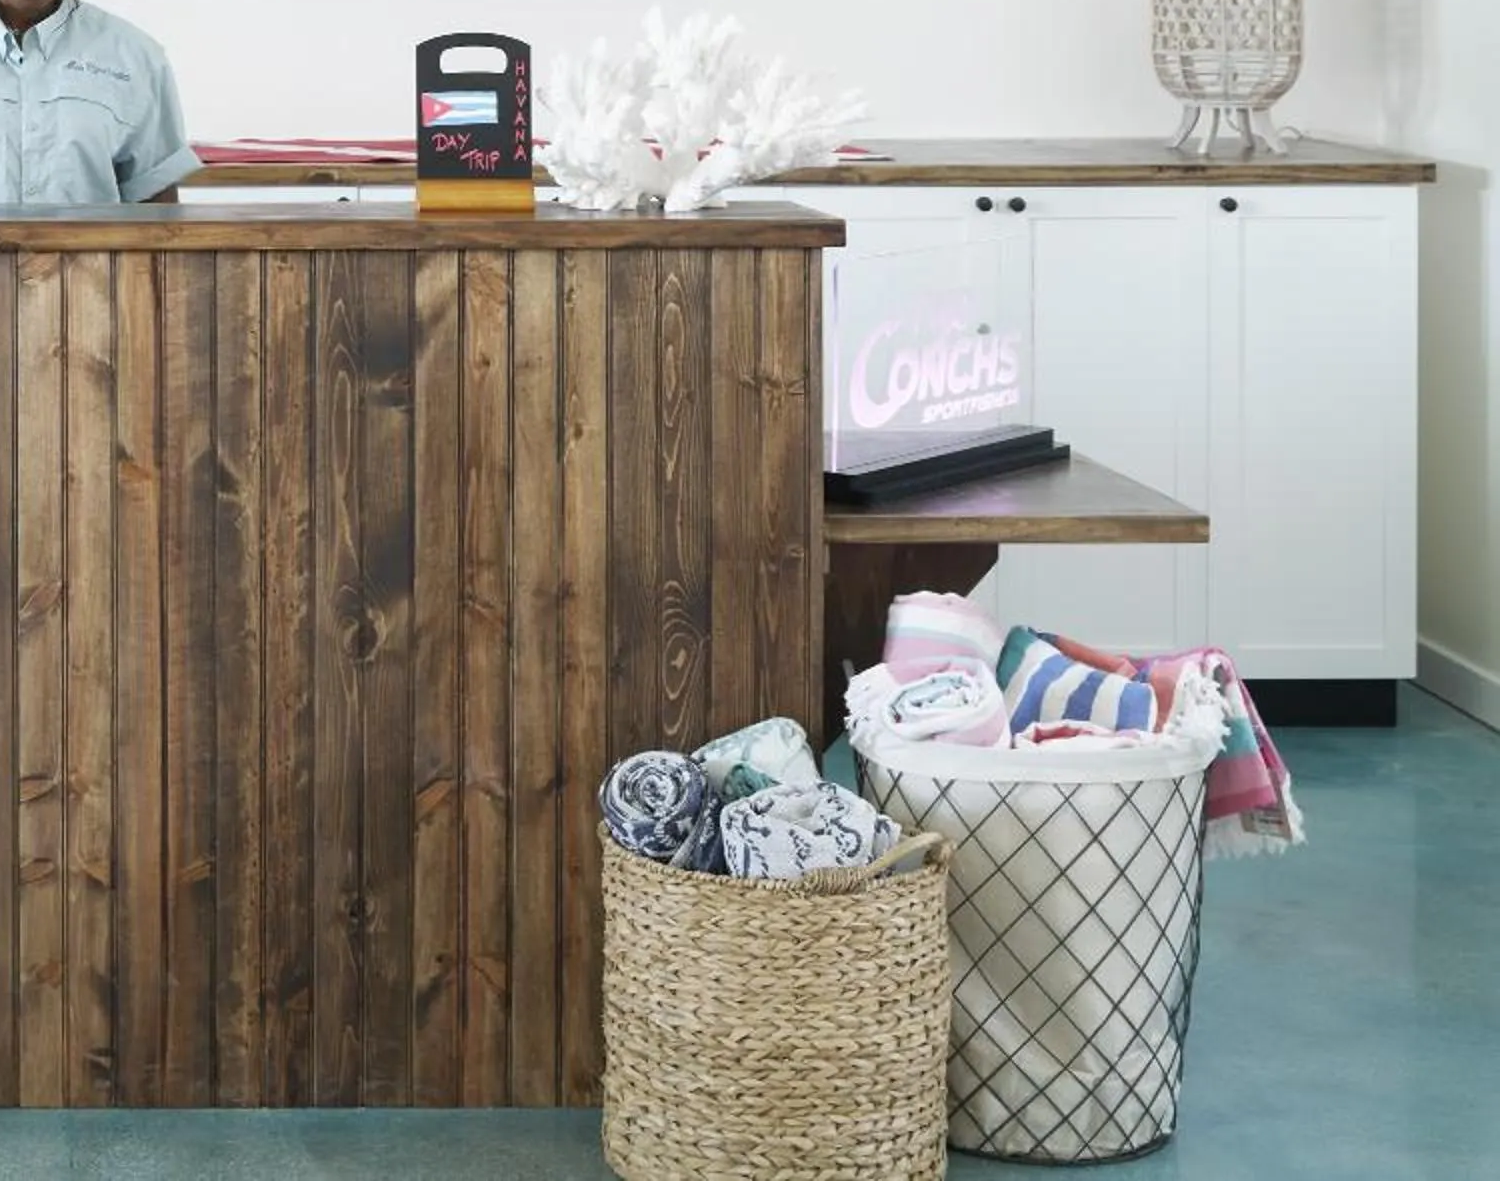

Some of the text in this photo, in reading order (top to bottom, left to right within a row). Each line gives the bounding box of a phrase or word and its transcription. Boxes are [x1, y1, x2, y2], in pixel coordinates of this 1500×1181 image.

[514, 58, 528, 161] HAVANA
[431, 131, 471, 152] DAY
[460, 148, 501, 171] TRIP
